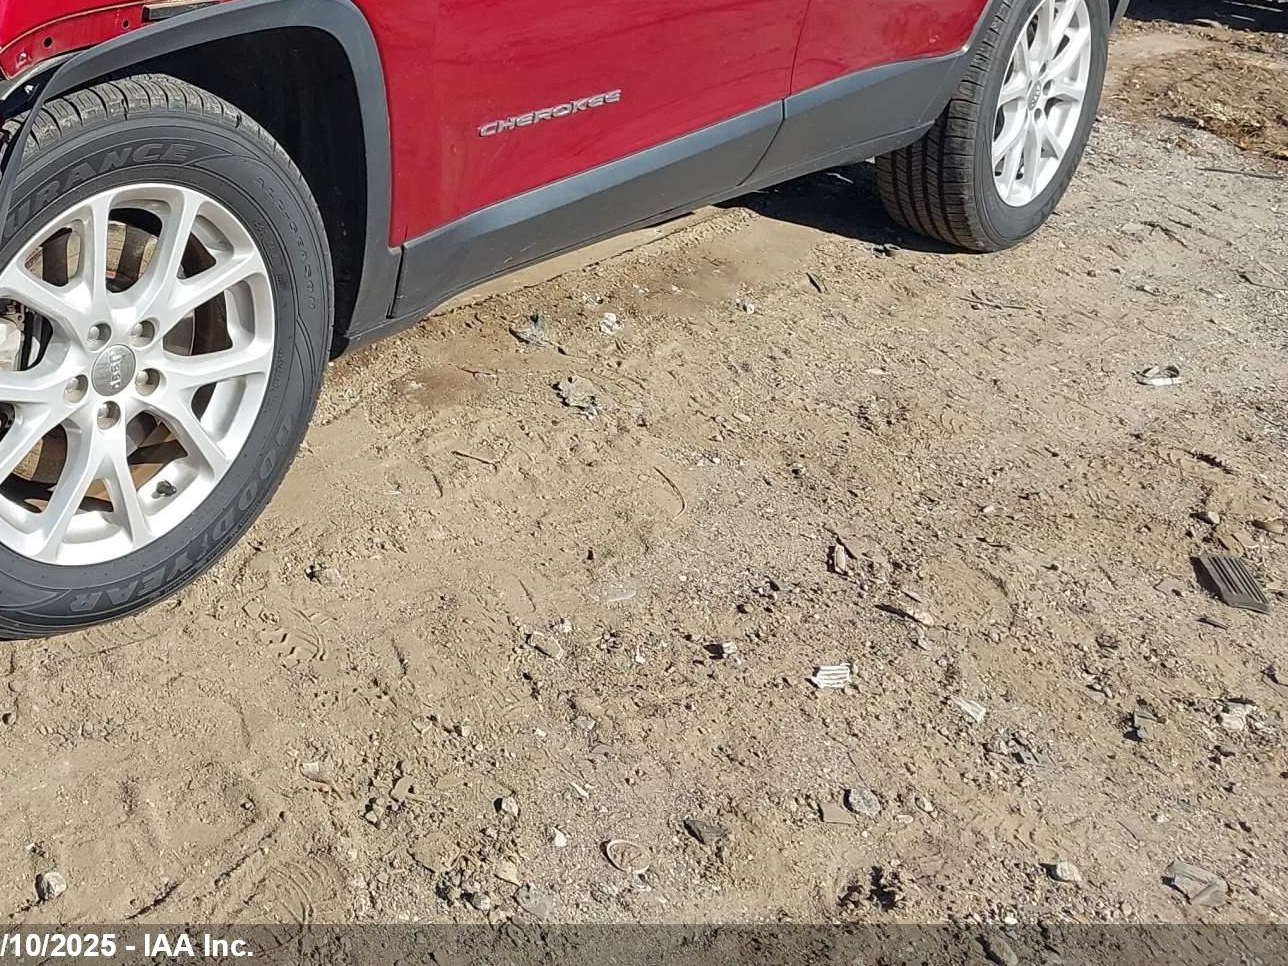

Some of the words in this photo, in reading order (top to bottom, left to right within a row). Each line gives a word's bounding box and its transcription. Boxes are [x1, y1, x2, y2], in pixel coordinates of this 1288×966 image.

[478, 89, 622, 137] CHEROKEE
[2, 141, 196, 239] URANCE
[69, 414, 297, 612] GOODYEAR
